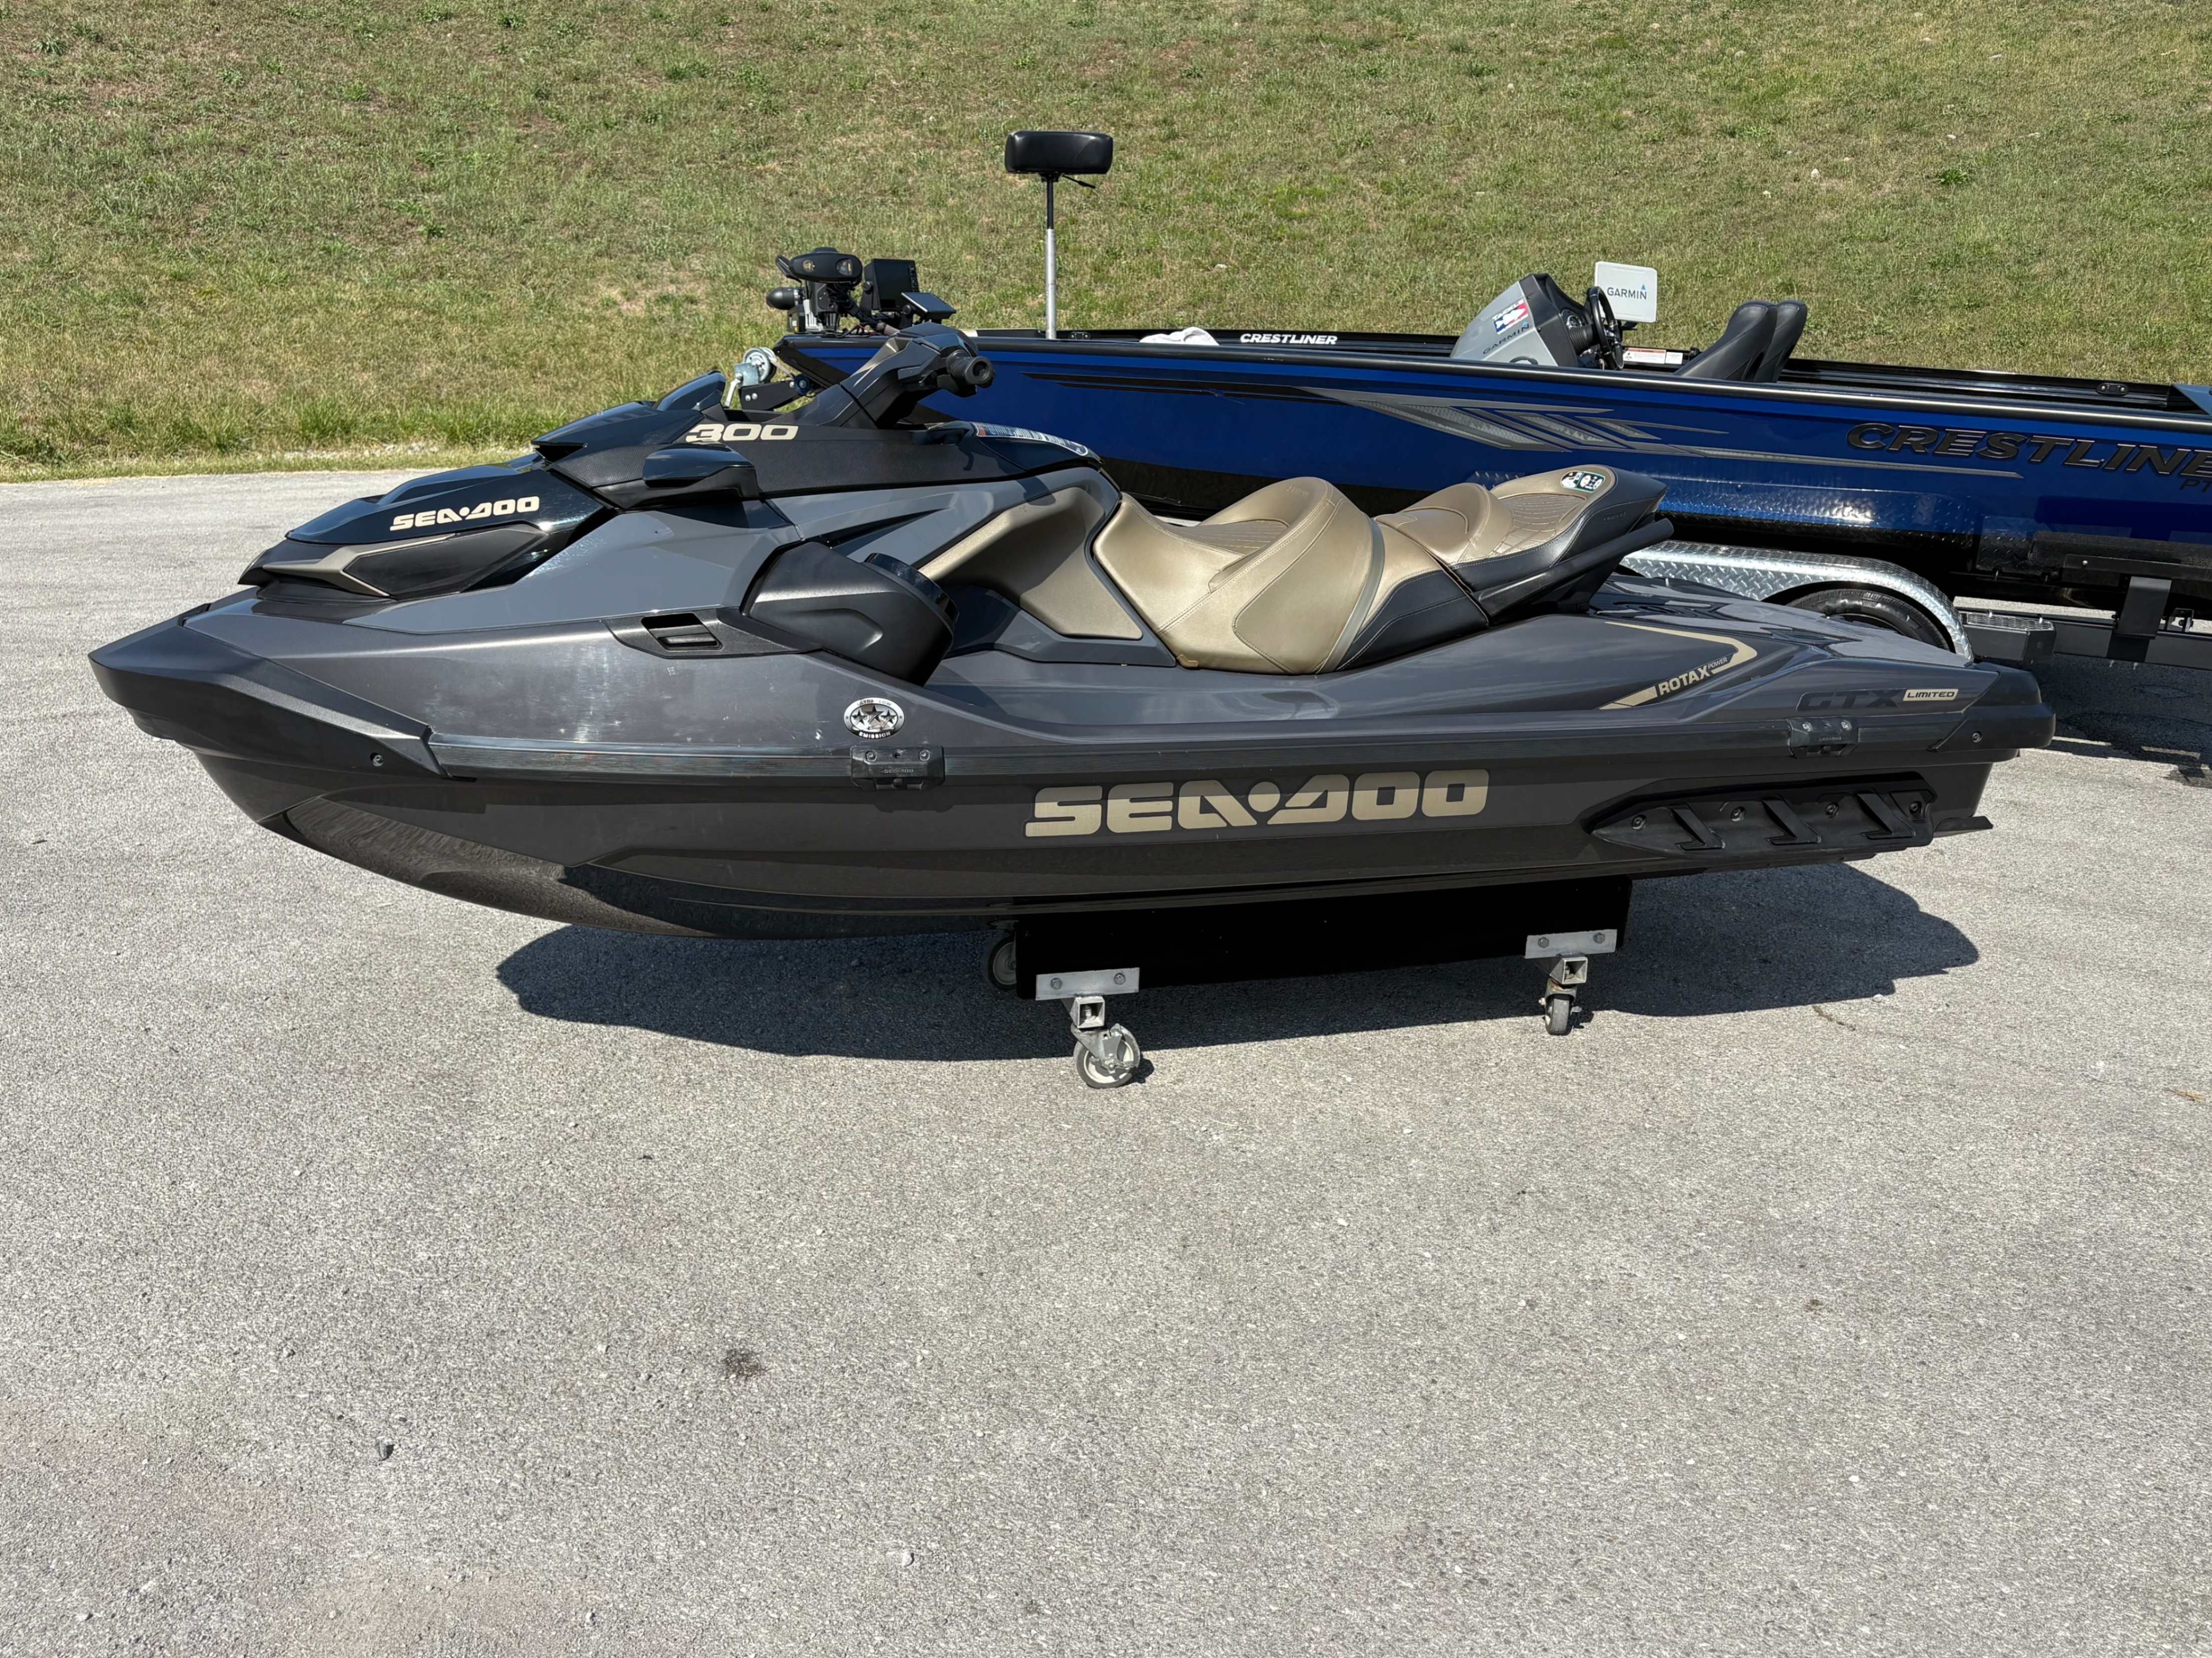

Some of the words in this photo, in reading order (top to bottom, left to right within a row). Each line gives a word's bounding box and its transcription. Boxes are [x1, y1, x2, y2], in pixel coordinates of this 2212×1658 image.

[1607, 286, 1647, 300] GARMIN
[1240, 333, 1338, 345] CRESTLINER
[1483, 320, 1530, 354] GARMIN
[685, 423, 799, 445] 300
[1658, 665, 1710, 696] ROTAX
[1708, 657, 1727, 670] POWER
[1797, 689, 1902, 710] GTX
[859, 731, 891, 739] EMISSION
